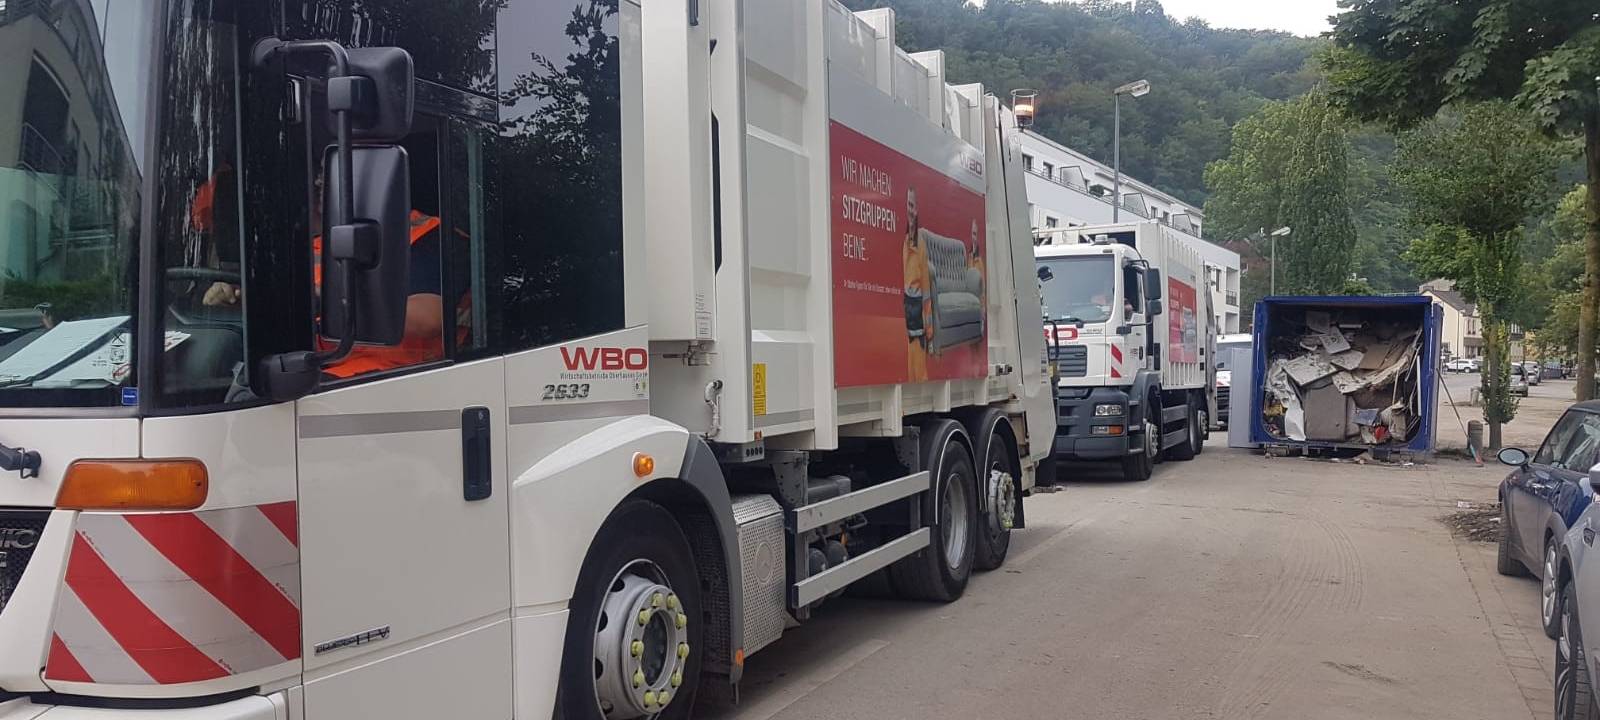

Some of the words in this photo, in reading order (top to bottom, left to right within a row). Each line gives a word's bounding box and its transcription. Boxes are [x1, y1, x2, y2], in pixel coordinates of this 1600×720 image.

[841, 154, 857, 184] WIR
[859, 162, 892, 197] MACHEN
[842, 194, 896, 233] SITZGRUPPEN
[560, 346, 648, 371] WBO
[542, 383, 590, 400] 2633
